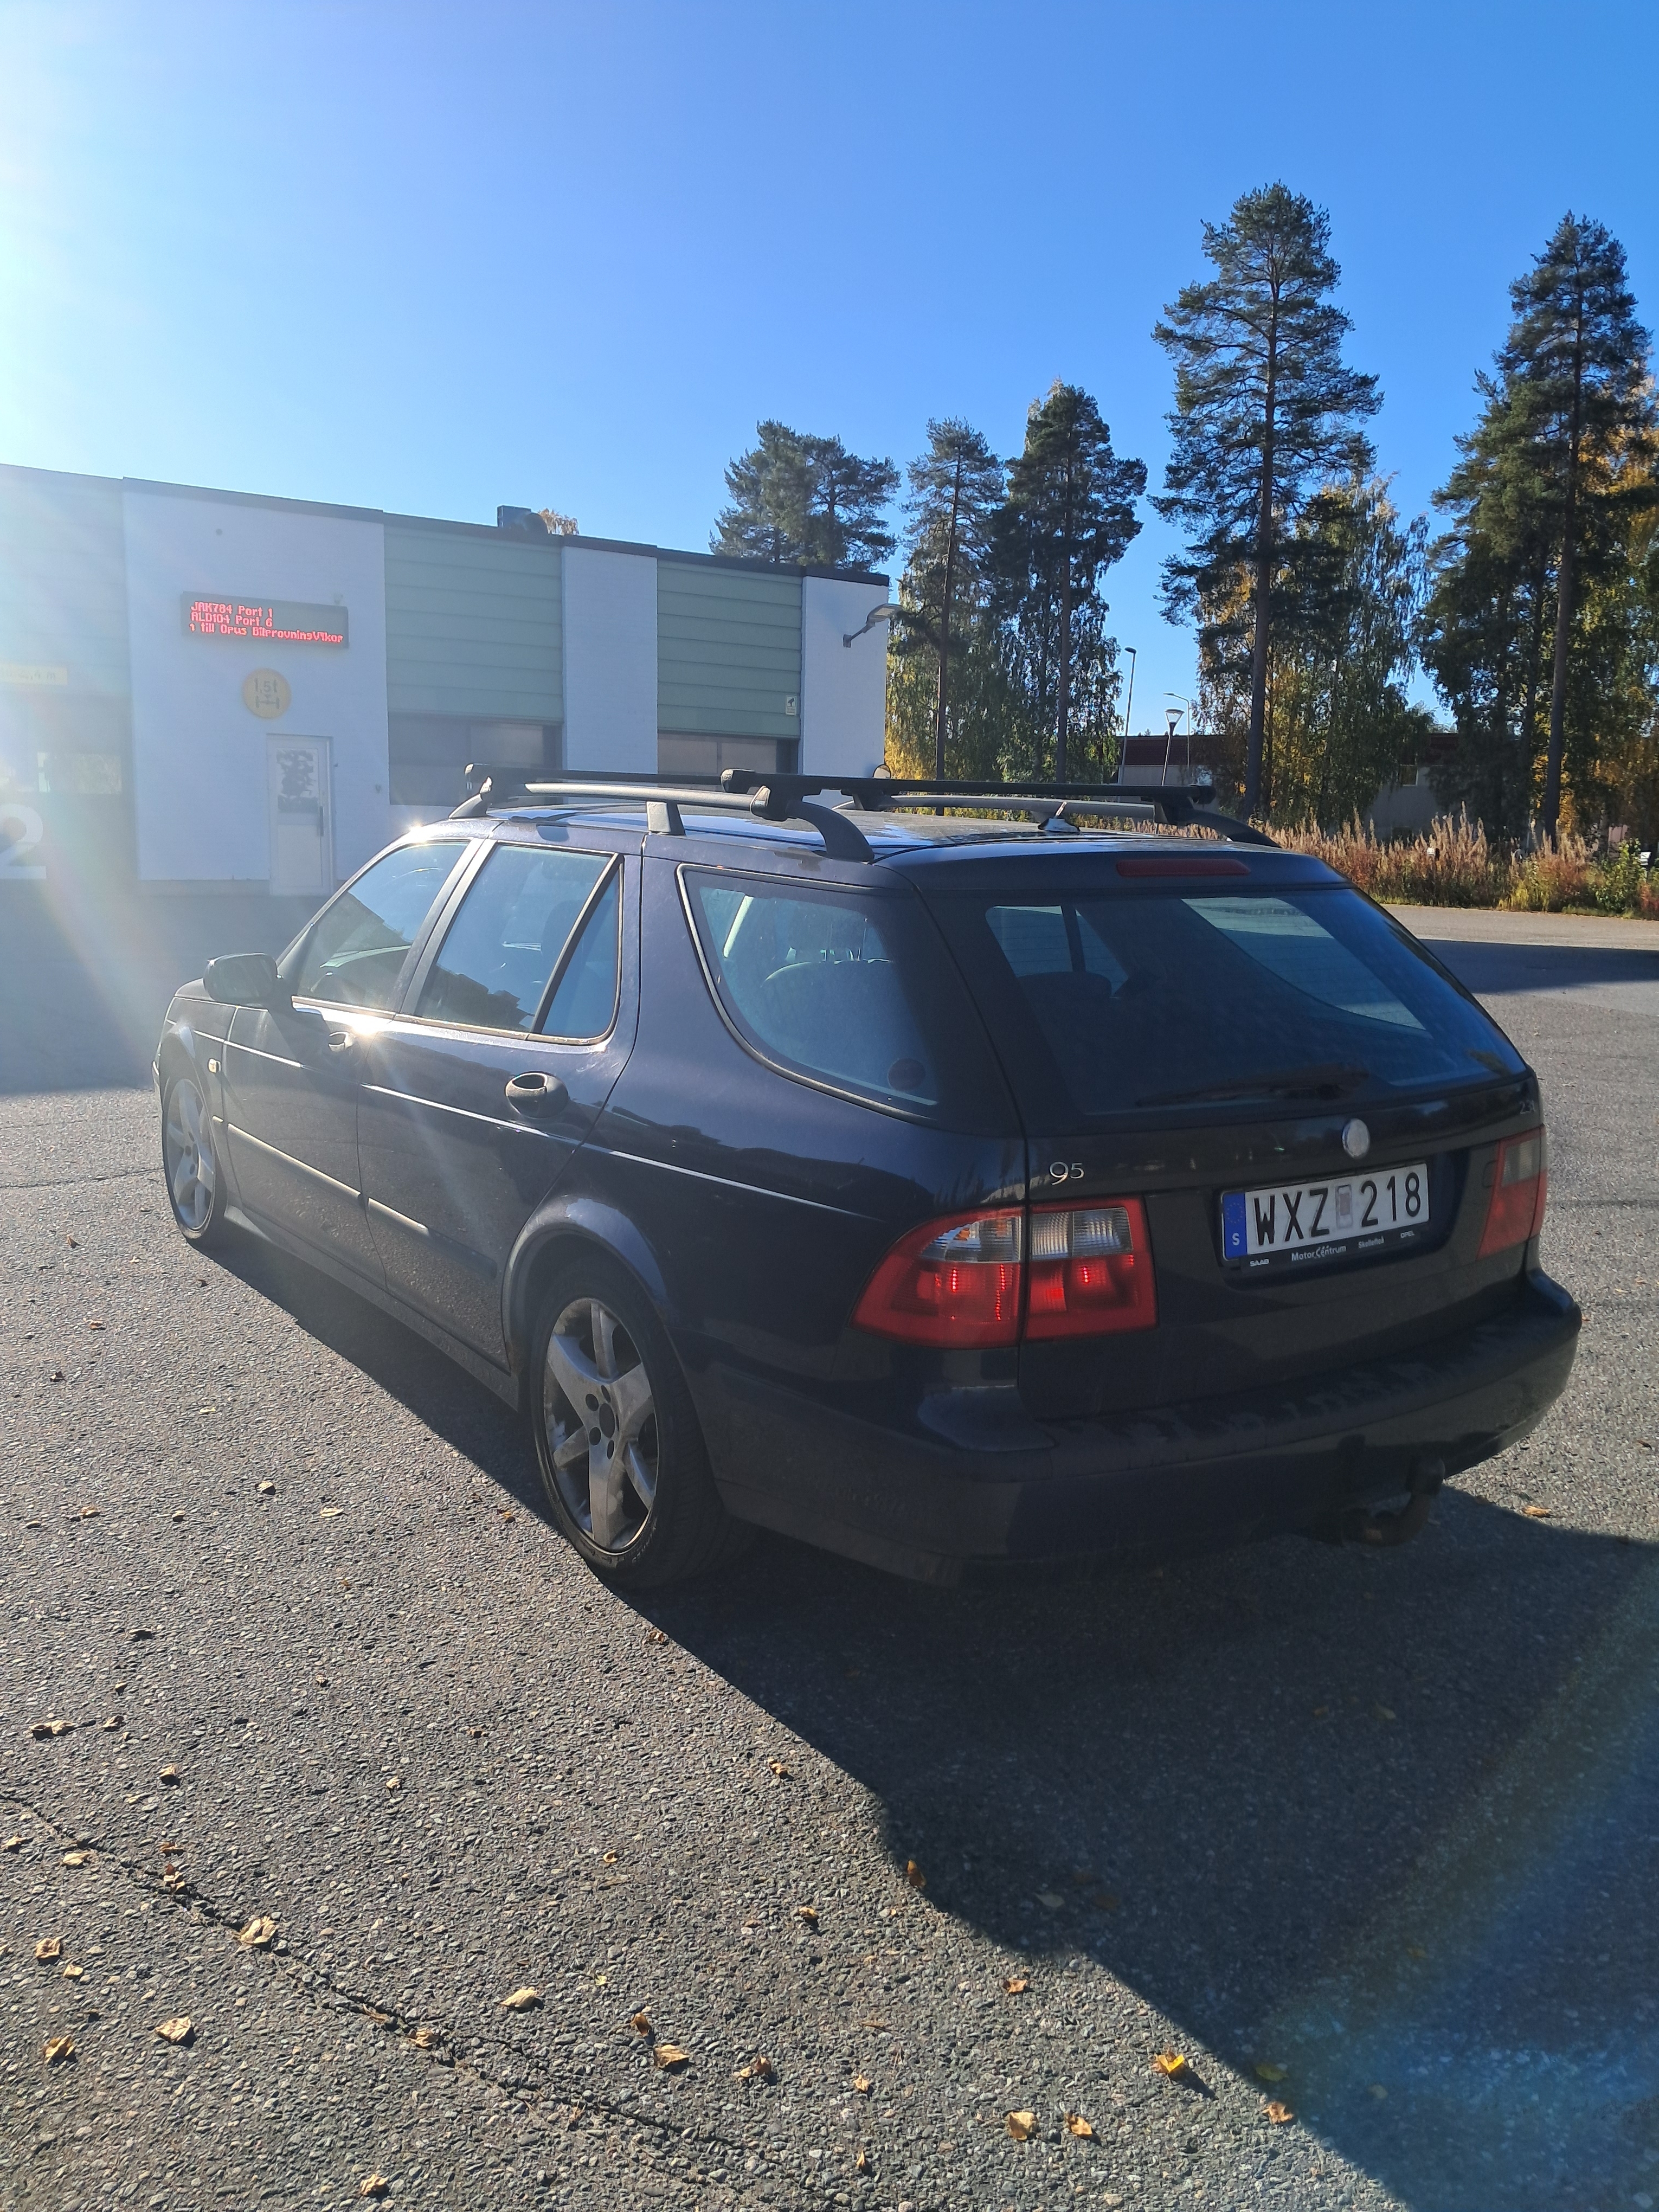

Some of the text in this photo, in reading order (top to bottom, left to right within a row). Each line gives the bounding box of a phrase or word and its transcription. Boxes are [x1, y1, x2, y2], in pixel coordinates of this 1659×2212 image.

[191, 601, 273, 618] JAK784 Port 1
[191, 612, 273, 627] ALD104 Port 6
[220, 623, 247, 635] Opus
[0, 802, 46, 879] 2
[1050, 1161, 1084, 1185] 95
[1253, 1172, 1421, 1246] WXZ 218
[1232, 1232, 1240, 1246] S
[1250, 1258, 1269, 1267] SAAB
[1400, 1230, 1414, 1238] OPEL
